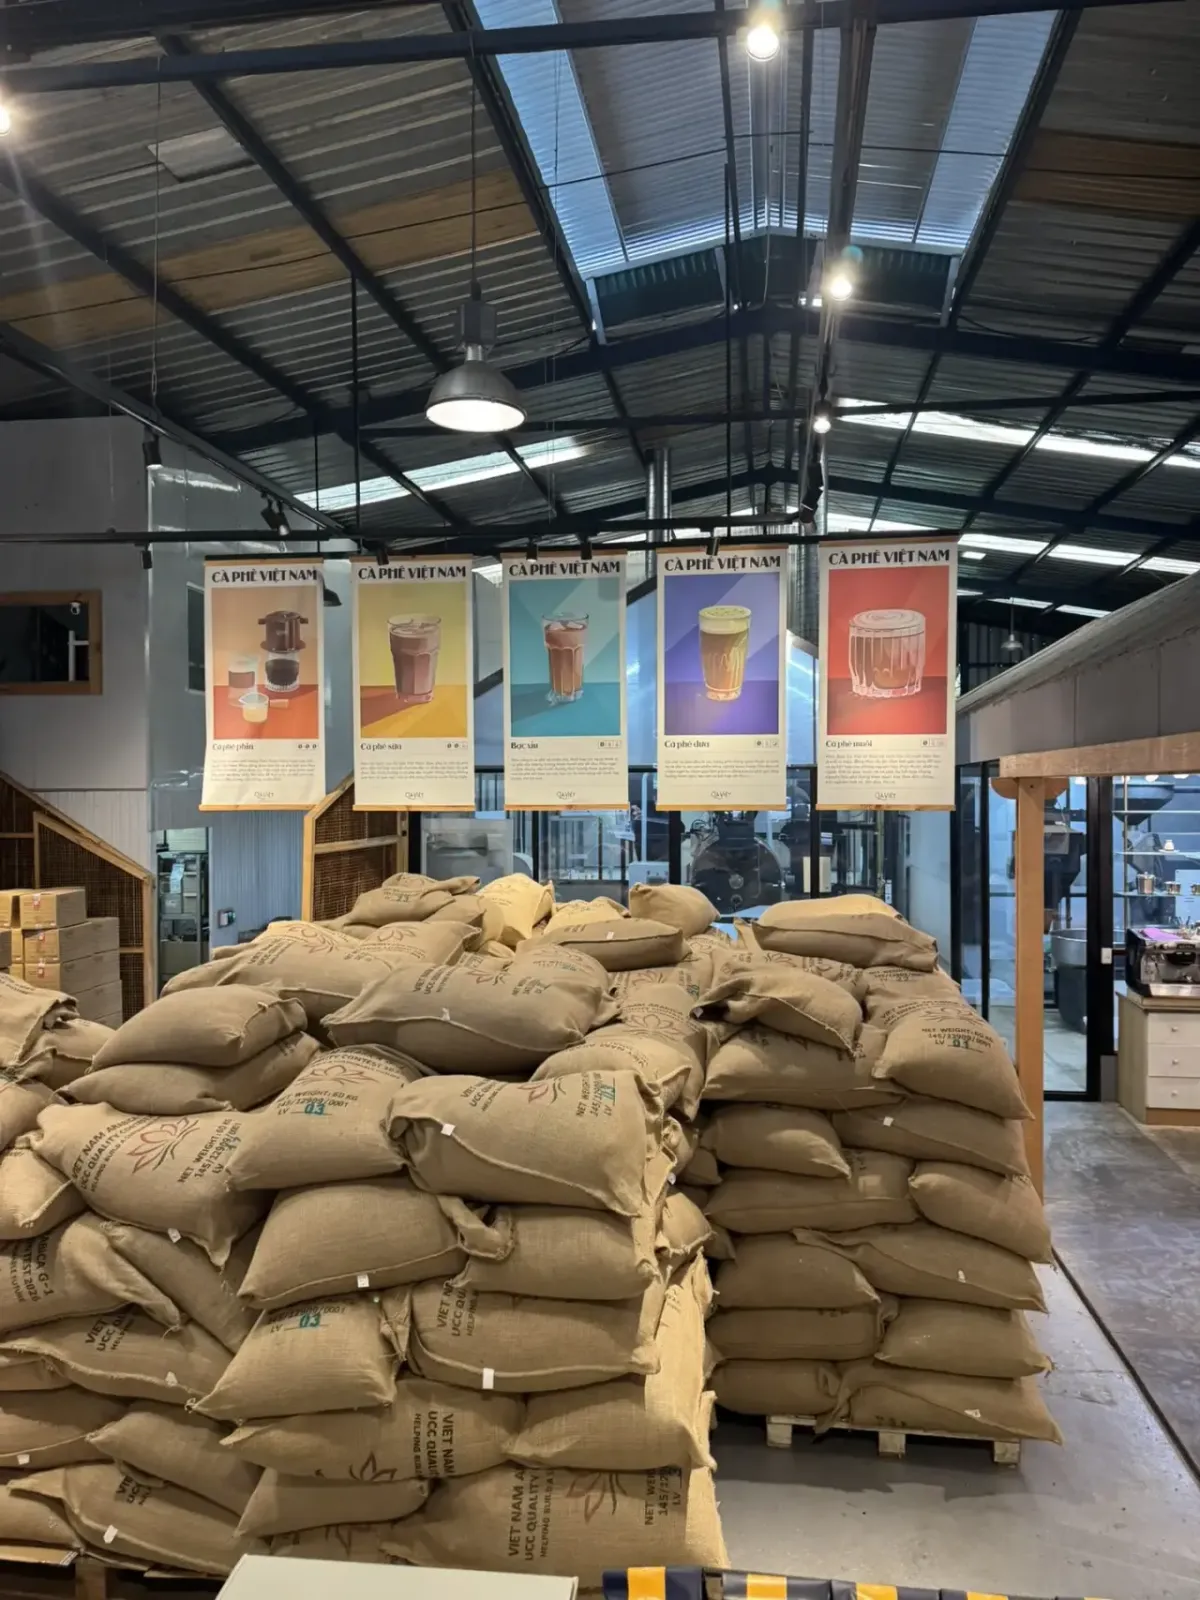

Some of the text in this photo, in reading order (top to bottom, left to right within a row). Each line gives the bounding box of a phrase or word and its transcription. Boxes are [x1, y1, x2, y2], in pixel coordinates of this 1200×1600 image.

[590, 561, 620, 573] NAM
[749, 555, 780, 568] NAM
[917, 549, 950, 562] NAM
[289, 569, 317, 581] NAM
[437, 566, 466, 577] NAM
[304, 1103, 326, 1115] 03
[469, 1091, 485, 1107] UCC
[71, 1154, 84, 1179] VIET
[82, 1131, 106, 1156] NAM
[87, 1133, 120, 1170] QUALITY
[177, 1166, 194, 1183] NET
[211, 1163, 224, 1174] LV
[38, 1272, 55, 1296] G-1
[299, 1313, 321, 1328] 03
[436, 1300, 451, 1328] VIET
[451, 1311, 463, 1337] UCC
[85, 1318, 109, 1343] VIET
[96, 1328, 116, 1352] UCC
[413, 1413, 421, 1453] HELPING
[426, 1410, 439, 1438] UCC
[441, 1413, 456, 1474] VIET NAM
[511, 1485, 524, 1523] NAM
[672, 1491, 681, 1506] LV
[524, 1474, 540, 1561] UCC QUALITY
[644, 1500, 654, 1526] NET
[508, 1525, 521, 1557] VIET
[540, 1517, 550, 1558] HELPING
